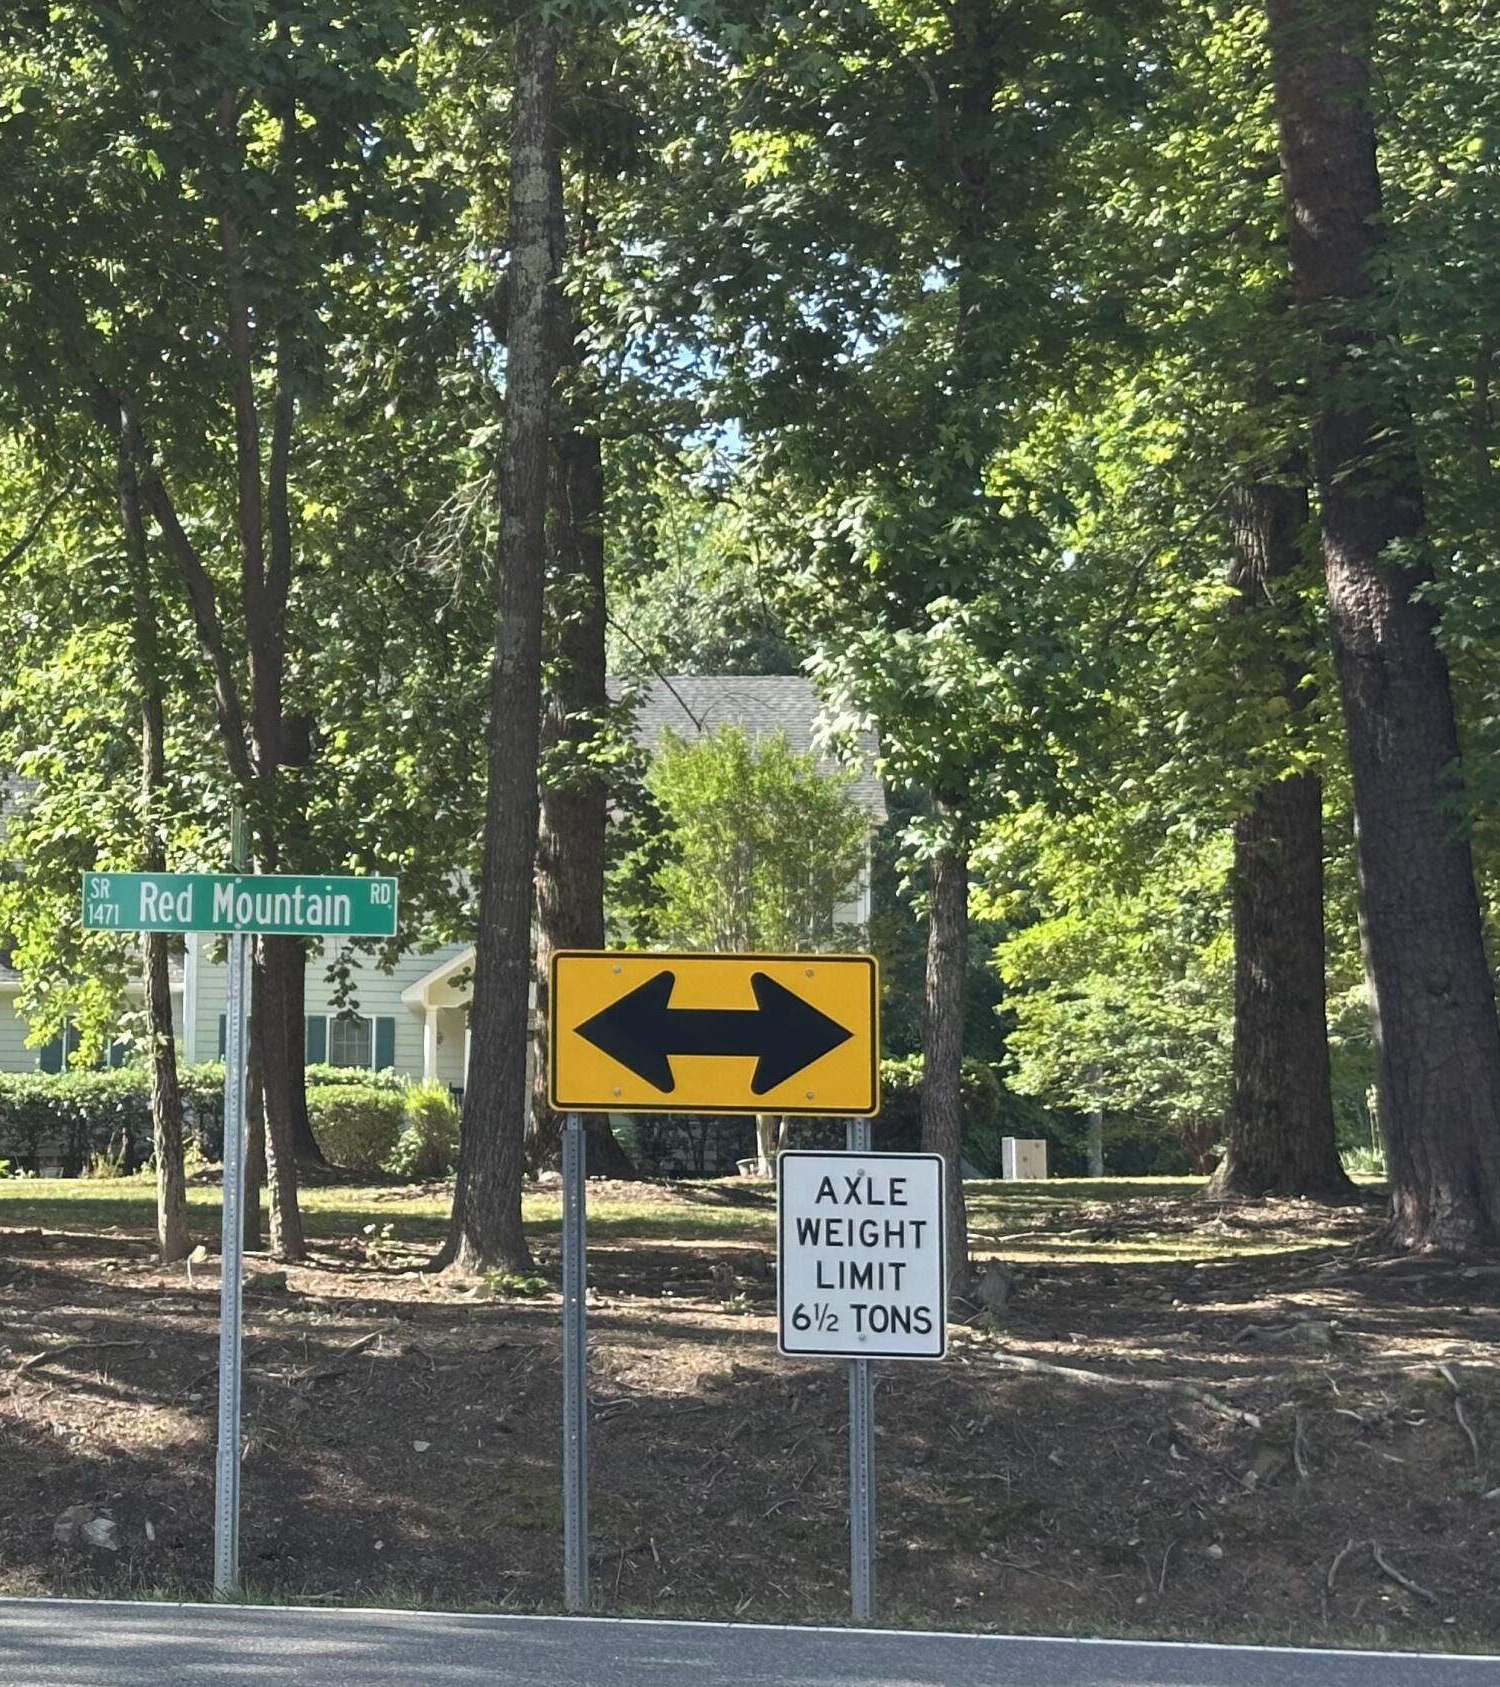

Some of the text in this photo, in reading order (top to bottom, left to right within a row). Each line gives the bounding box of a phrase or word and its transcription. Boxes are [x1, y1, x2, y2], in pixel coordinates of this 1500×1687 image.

[90, 878, 110, 899] SR
[139, 881, 390, 926] Red Mountain RD
[88, 903, 119, 925] 1471
[814, 1175, 908, 1206] AXLE
[796, 1217, 927, 1249] WEIGHT
[816, 1260, 907, 1291] LIMIT
[850, 1304, 933, 1334] TONS
